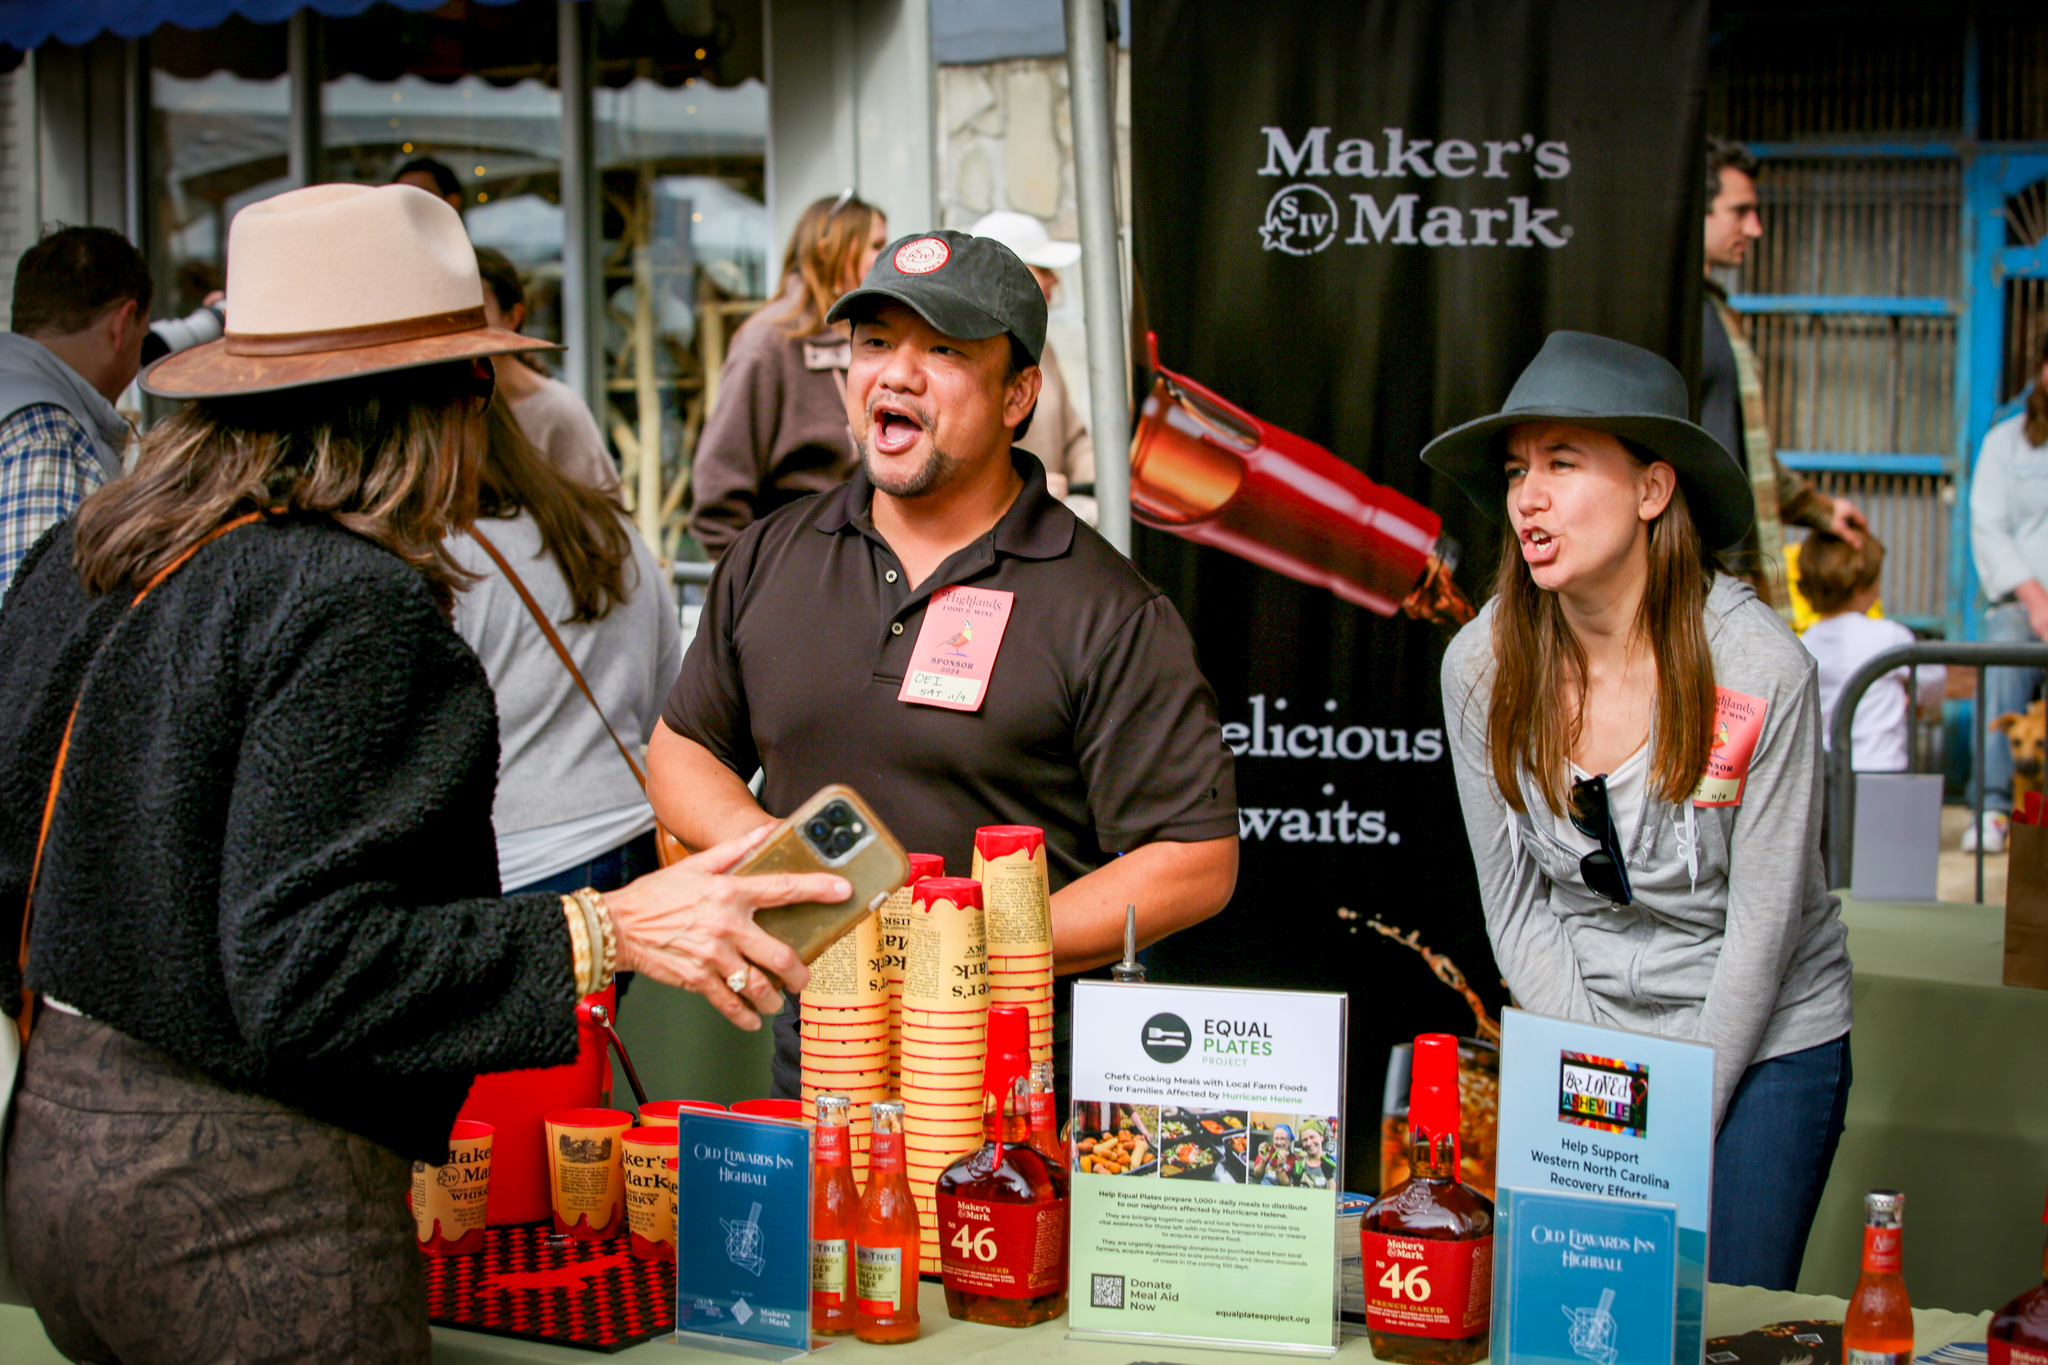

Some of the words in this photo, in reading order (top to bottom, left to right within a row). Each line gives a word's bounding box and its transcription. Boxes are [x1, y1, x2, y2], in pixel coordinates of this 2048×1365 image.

[1257, 126, 1571, 179] Maker's
[1344, 193, 1568, 248] Mark
[942, 590, 1002, 611] Highlands
[942, 605, 964, 614] FOOD
[974, 609, 995, 618] WINE
[931, 657, 974, 670] SPONSOR
[919, 688, 943, 698] SAT
[1716, 695, 1756, 717] ghlands
[1729, 711, 1748, 722] WINE
[1222, 693, 1444, 762] elicious
[1708, 761, 1734, 772] NSOR
[1238, 783, 1401, 846] waits.
[953, 961, 988, 980] ark
[1203, 1018, 1273, 1038] EQUAL
[1203, 1038, 1273, 1056] PLATES
[1202, 1056, 1248, 1067] PROJECT
[1104, 1072, 1130, 1081] Chefs
[1132, 1073, 1171, 1085] Cooking
[1173, 1076, 1200, 1085] Meals
[1202, 1078, 1223, 1087] with
[1225, 1079, 1250, 1088] Local
[1252, 1081, 1276, 1090] Farm
[1278, 1082, 1308, 1092] Foods
[1108, 1084, 1123, 1093] For
[1125, 1085, 1163, 1095] Families
[1166, 1087, 1206, 1098] Affected
[1208, 1090, 1219, 1100] by
[1222, 1091, 1267, 1101] Hurricane
[1270, 1094, 1302, 1104] Helene
[1562, 1092, 1630, 1121] ASHEVILLE
[1561, 1138, 1588, 1156] Help
[1591, 1144, 1640, 1165] Support
[719, 1166, 768, 1187] HIGHBALL
[1531, 1149, 1580, 1171] Western
[1583, 1161, 1618, 1179] North
[1620, 1169, 1671, 1189] Carolina
[451, 1189, 488, 1201] WHISK
[1550, 1172, 1604, 1195] Recovery
[1607, 1184, 1648, 1200] Efforts
[957, 1200, 991, 1214] Maker's
[1098, 1190, 1116, 1199] Help
[1116, 1191, 1138, 1201] Equal
[1139, 1192, 1162, 1201] Plates
[1163, 1195, 1192, 1204] prepare
[1193, 1196, 1216, 1206] 1,000+
[1218, 1198, 1236, 1207] daily
[1238, 1199, 1260, 1207] meals
[1271, 1201, 1307, 1211] distribute
[965, 1210, 991, 1222] Mark
[1140, 1202, 1177, 1212] neighbors
[1179, 1205, 1210, 1213] affected
[1211, 1207, 1220, 1215] by
[1222, 1208, 1258, 1217] Hurricane
[1259, 1210, 1287, 1218] Helene.
[1112, 1220, 1143, 1228] assistance
[1207, 1226, 1230, 1235] homes,
[1231, 1228, 1276, 1238] transportation,
[1131, 1214, 1157, 1222] bringing
[1158, 1216, 1184, 1224] together
[1263, 1223, 1287, 1232] provide
[951, 1223, 998, 1262] 46
[1169, 1232, 1192, 1240] acquire
[1101, 1238, 1116, 1246] They
[1127, 1240, 1153, 1249] urgently
[1154, 1242, 1187, 1251] requesting
[1188, 1244, 1218, 1252] donations
[1226, 1247, 1255, 1256] purchase
[1387, 1239, 1425, 1252] Maker's
[1095, 1245, 1120, 1254] farmers,
[1121, 1247, 1144, 1256] acquire
[1144, 1249, 1178, 1258] equipment
[1203, 1253, 1238, 1262] production,
[1275, 1258, 1307, 1266] thousands
[1396, 1249, 1424, 1261] Mark
[1562, 1249, 1624, 1272] HIGHBALL
[1197, 1260, 1221, 1268] coming
[1233, 1263, 1249, 1271] days.
[1130, 1278, 1172, 1290] Donate
[1378, 1262, 1432, 1302] 46
[1130, 1290, 1157, 1301] Meal
[1160, 1292, 1180, 1302] Aid
[760, 1308, 791, 1320] Maker's
[1130, 1301, 1156, 1312] Now
[1371, 1298, 1408, 1311] FRENCH
[1409, 1304, 1444, 1315] OAKED
[768, 1317, 790, 1328] Mark
[1215, 1308, 1310, 1324] equalplatesproject.org
